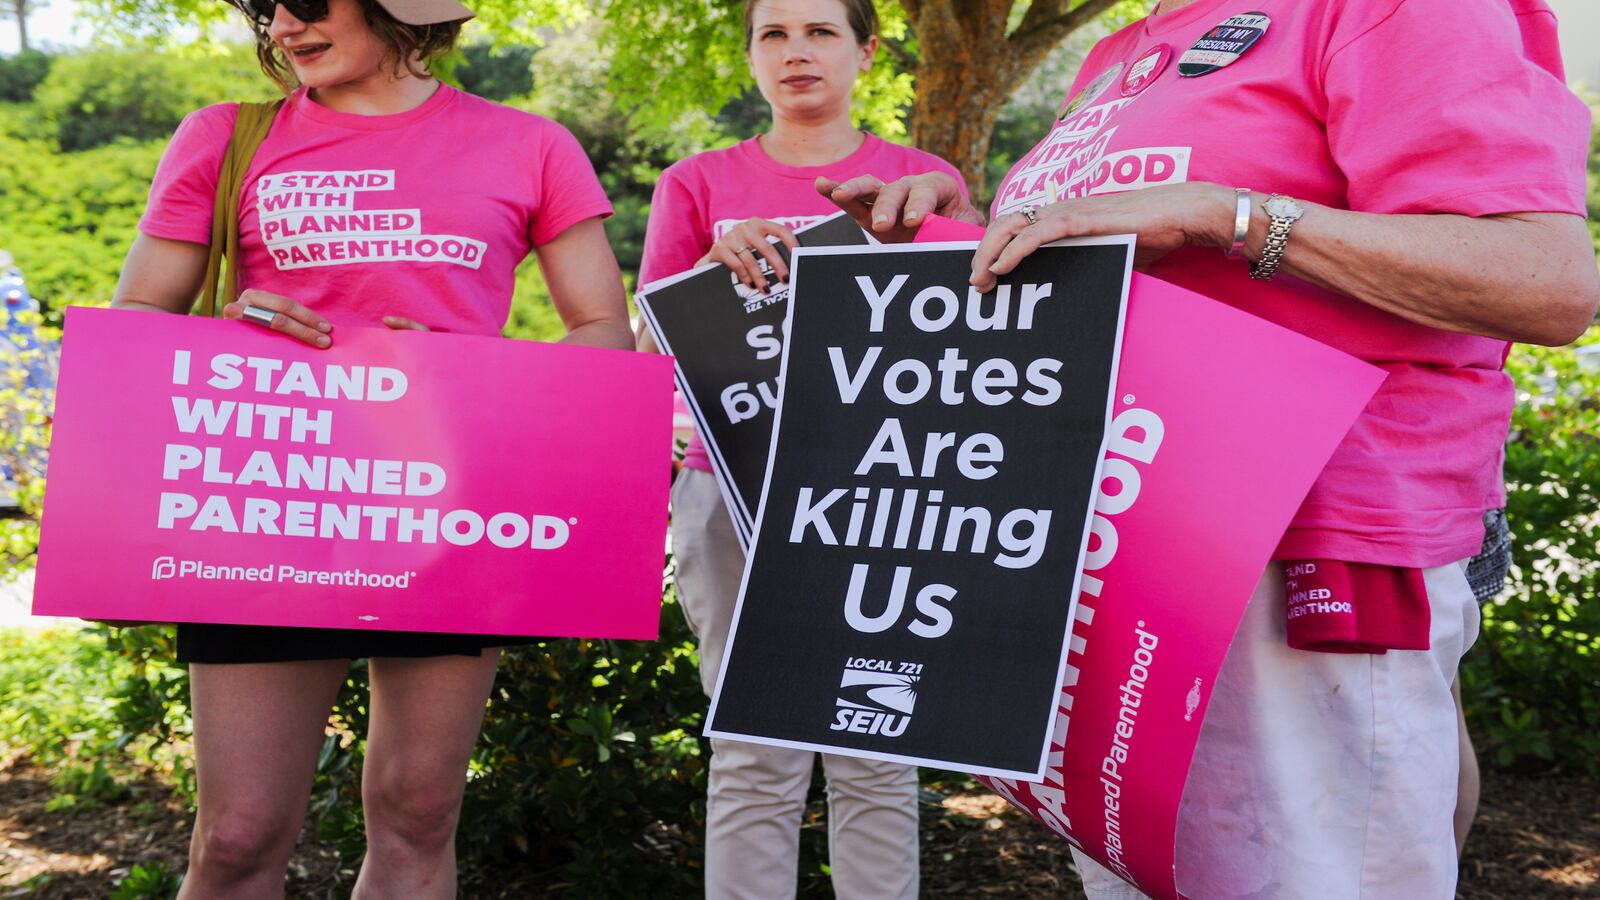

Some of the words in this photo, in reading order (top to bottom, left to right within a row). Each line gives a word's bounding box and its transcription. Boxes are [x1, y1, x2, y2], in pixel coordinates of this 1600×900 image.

[1192, 39, 1243, 52] PRESIDENT
[1207, 27, 1236, 38] NOT
[1229, 29, 1253, 40] MY
[262, 179, 271, 190] I
[281, 174, 389, 188] STAND
[263, 191, 347, 212] WITH
[264, 213, 414, 241] PLANNED
[273, 239, 479, 266] PARENTHOOD
[745, 301, 763, 314] 721
[763, 291, 788, 306] OCAL
[854, 273, 1053, 333] Your
[173, 350, 191, 385] I
[207, 353, 409, 402] STAND
[827, 346, 1064, 407] Votes
[172, 397, 333, 445] WITH
[853, 418, 1004, 480] Are
[161, 444, 447, 497] PLANNED
[789, 487, 1053, 570] Killing
[179, 560, 274, 583] Planned
[844, 563, 958, 638] Us
[845, 657, 893, 672] LOCAL
[897, 662, 924, 675] 721
[830, 708, 912, 737] SEIU
[1100, 776, 1127, 868] Planned
